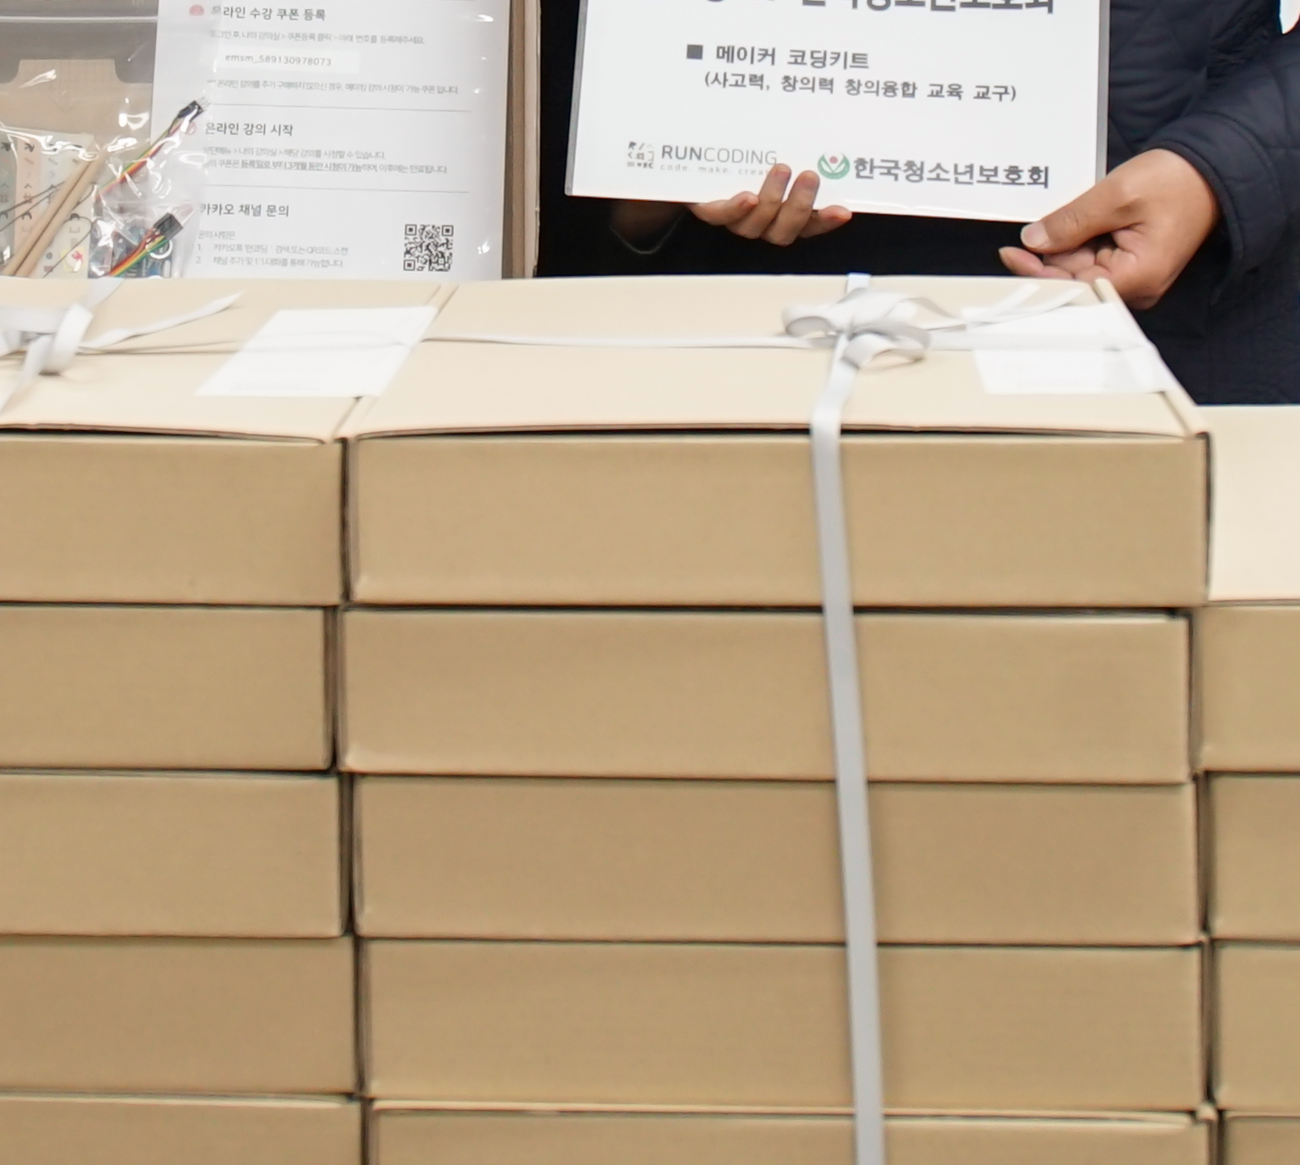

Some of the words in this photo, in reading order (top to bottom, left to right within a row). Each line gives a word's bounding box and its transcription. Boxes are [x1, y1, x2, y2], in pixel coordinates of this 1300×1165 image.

[250, 6, 272, 20] 수강
[276, 8, 300, 21] 쿠폰
[303, 8, 326, 21] 등록
[716, 44, 776, 67] 메이커
[787, 48, 870, 70] 코딩키트
[704, 70, 770, 92] (사고력,
[780, 74, 835, 94] 창의력
[845, 77, 918, 99] 창의융합
[926, 82, 964, 101] 교육
[973, 85, 1017, 102] 교구)
[205, 122, 239, 136] 온라인
[243, 123, 266, 136] 강의
[270, 123, 293, 137] 시작
[660, 144, 778, 166] RUNCODING
[853, 155, 1050, 190] 한국청소년보호회
[200, 203, 235, 216] 카카오
[238, 203, 262, 217] 채널
[266, 204, 289, 217] 문의
